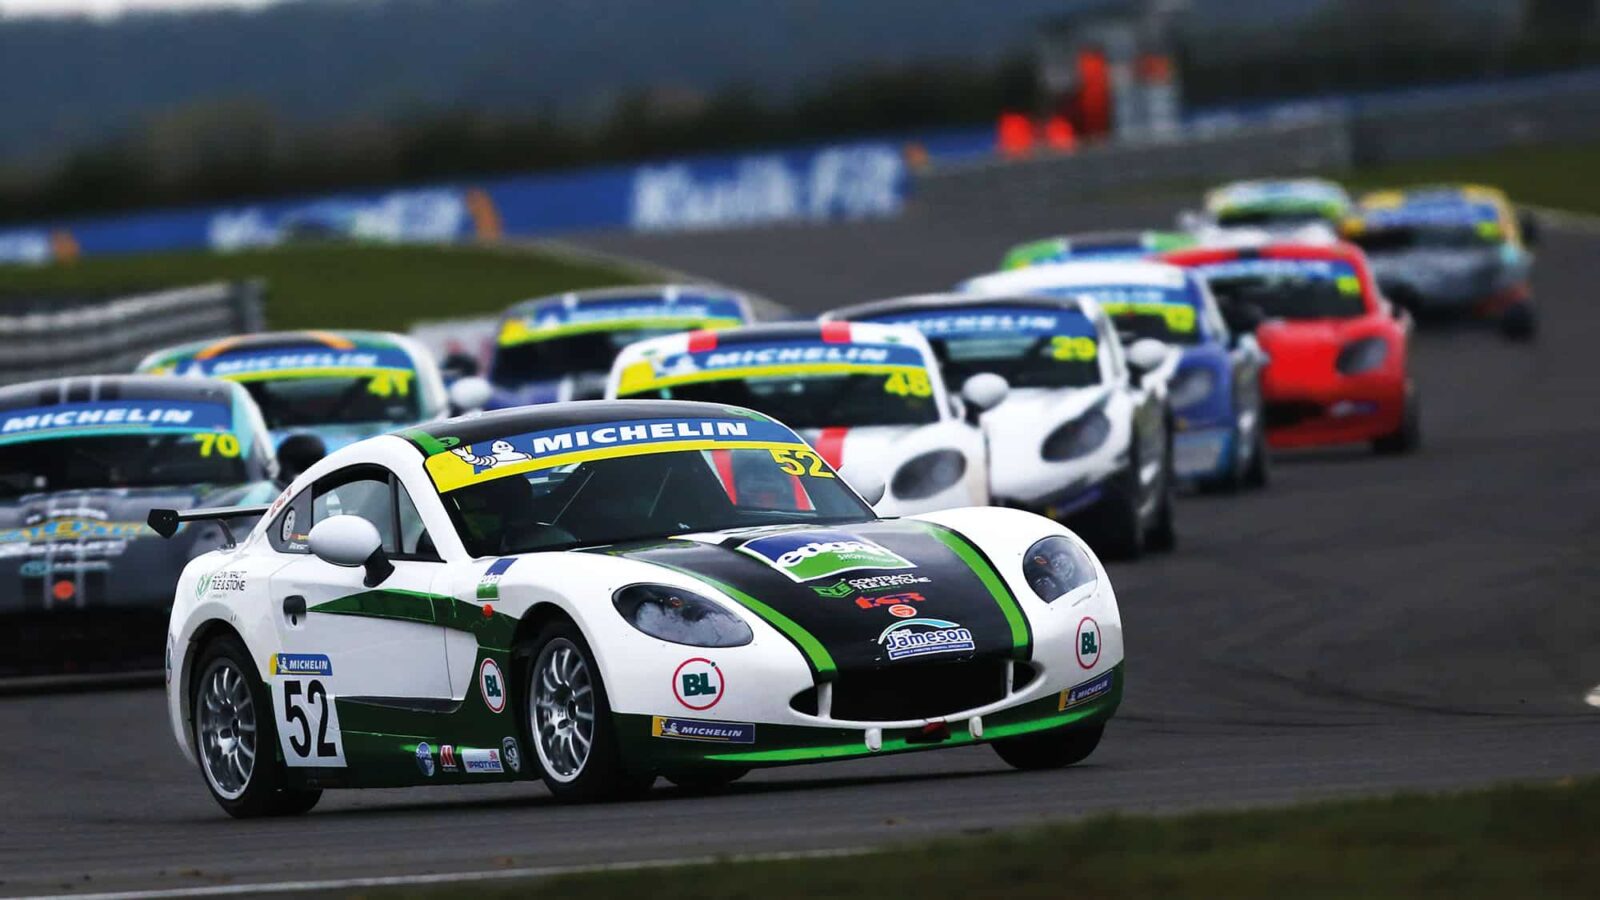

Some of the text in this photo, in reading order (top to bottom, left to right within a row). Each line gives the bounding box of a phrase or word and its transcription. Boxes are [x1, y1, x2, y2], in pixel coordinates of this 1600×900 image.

[706, 347, 889, 368] MICHELIN
[1050, 335, 1097, 361] 29
[368, 371, 410, 397] 41
[2, 409, 193, 432] MICHELIN
[193, 433, 241, 458] 70
[533, 422, 748, 454] MICHELIN
[769, 449, 835, 479] 52
[887, 629, 971, 649] Jameson
[1081, 631, 1098, 655] BL
[289, 659, 329, 671] MICHELIN
[484, 674, 502, 697] BL
[682, 672, 717, 697] BL
[284, 679, 337, 758] 52
[681, 726, 743, 737] MICHELIN
